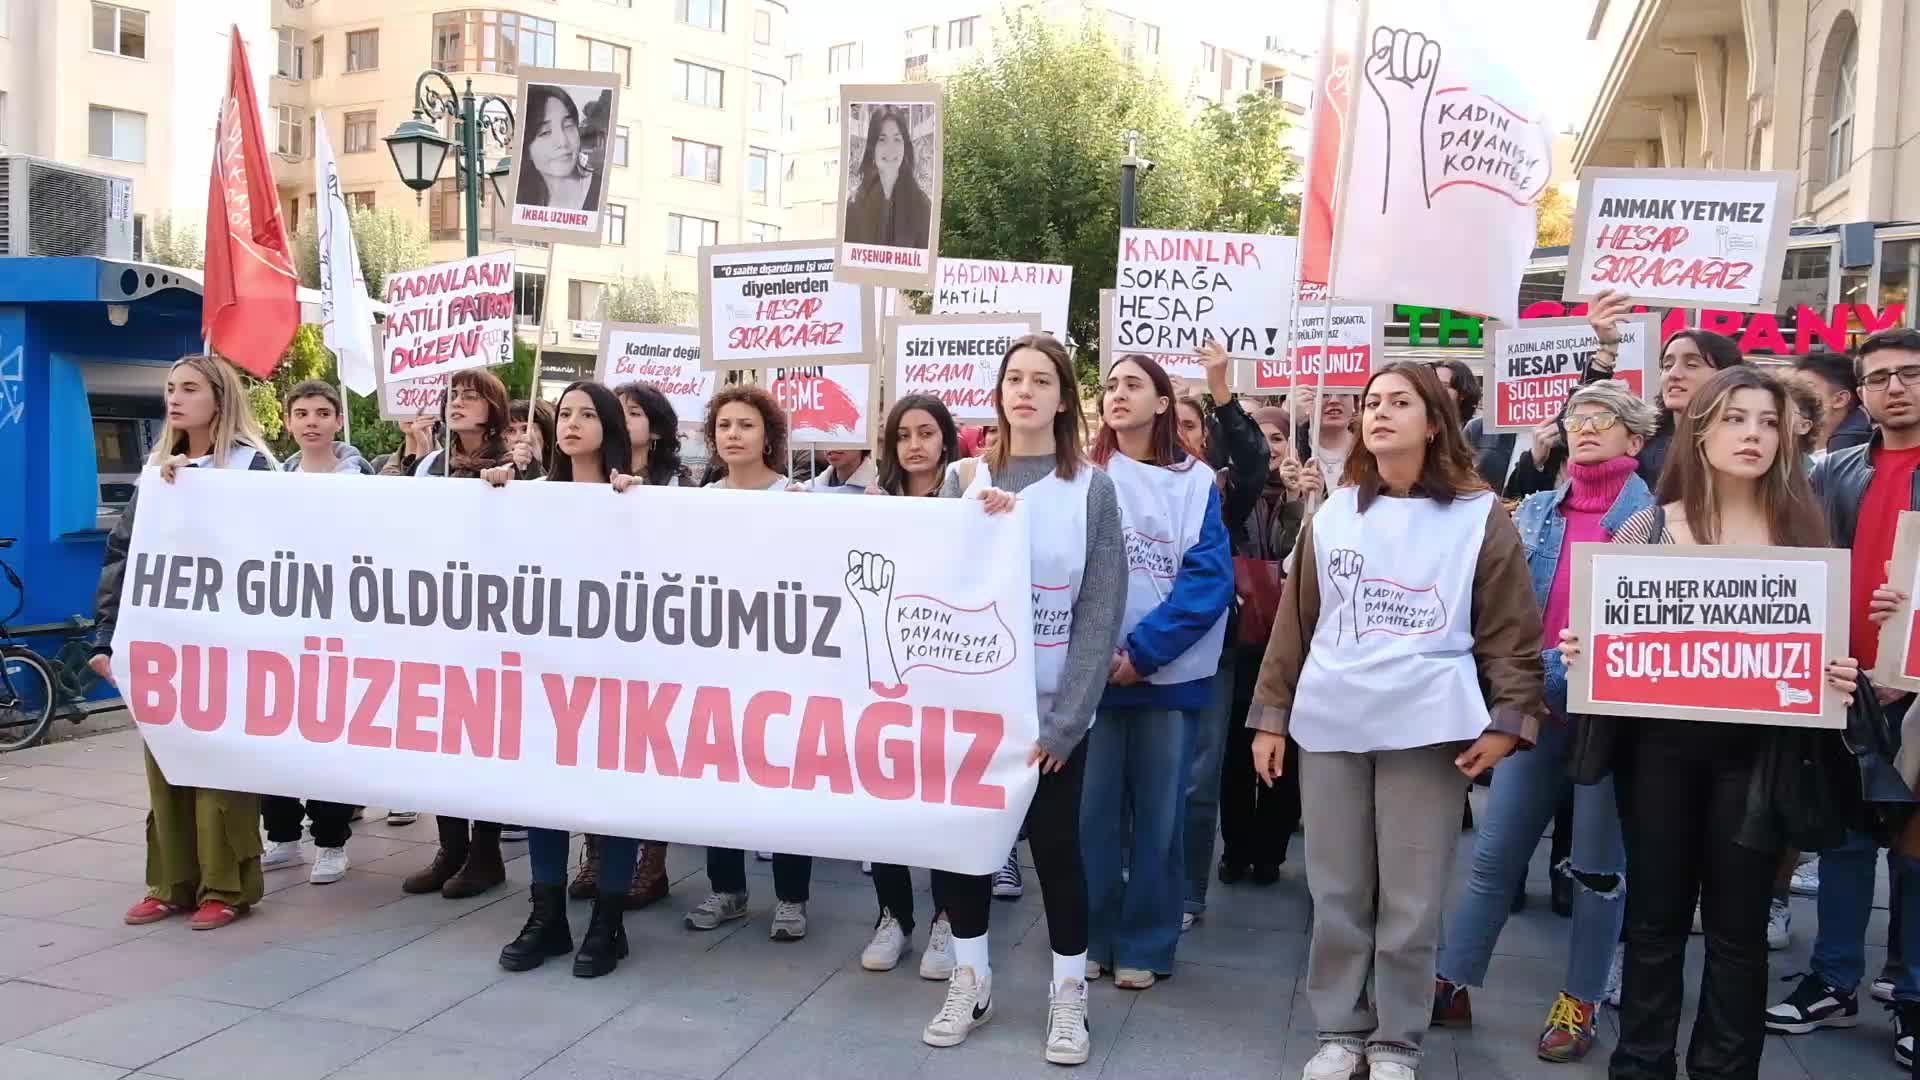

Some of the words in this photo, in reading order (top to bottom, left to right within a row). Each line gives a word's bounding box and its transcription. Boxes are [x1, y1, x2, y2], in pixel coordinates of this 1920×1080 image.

[1438, 103, 1510, 133] KADIN
[522, 207, 549, 222] İKBAL
[551, 211, 588, 226] UZUNER
[1598, 197, 1676, 220] ANMAK
[1680, 200, 1765, 223] YETMEZ
[1596, 223, 1689, 253] HESAP
[851, 248, 893, 264] AYŞENUR
[894, 251, 922, 267] HALİL
[1125, 236, 1262, 270] KADINLAR
[387, 262, 510, 303] KADINLARIN
[733, 266, 758, 276] saatte
[794, 264, 805, 272] ne
[943, 264, 1063, 286] KADINLARIN
[1120, 265, 1233, 292] SOKAĞA
[1591, 254, 1754, 290] SORACAĞIZ
[742, 277, 829, 298] diyenlerden
[939, 286, 998, 304] KATİLİ
[386, 300, 442, 339] KATİLİ
[756, 297, 823, 321] HESAP
[1119, 296, 1214, 322] HESAP
[390, 324, 484, 375] DÜZENİ
[625, 342, 671, 357] Kadınlar
[905, 337, 934, 357] SİZİ
[937, 336, 1017, 356] YENECEĞİ
[1508, 354, 1568, 377] HESAP
[1363, 587, 1404, 600] KADIN
[1617, 576, 1661, 600] ÖLEN
[1665, 579, 1699, 599] HER
[1703, 579, 1757, 598] KADIN
[1761, 574, 1796, 601] İÇİN
[131, 552, 224, 612] HER
[237, 550, 333, 620] GÜN
[349, 555, 841, 659] ÖLDÜRÜLDÜĞÜMÜZ
[898, 606, 952, 626] KADIN
[1365, 600, 1436, 618] DAYANIŞMA
[1605, 598, 1629, 625] İKİ
[1634, 598, 1695, 625] ELİMİZ
[1700, 602, 1811, 625] YAKANIZDA
[901, 625, 998, 648] DAYANIŞMA
[906, 644, 1001, 665] KOMİTELERİ
[1605, 641, 1812, 682] SUÇLUSUNUZ!
[129, 641, 229, 732] BU
[245, 635, 523, 761] DÜZENİ
[541, 673, 1006, 810] YIKACAĞIZ
